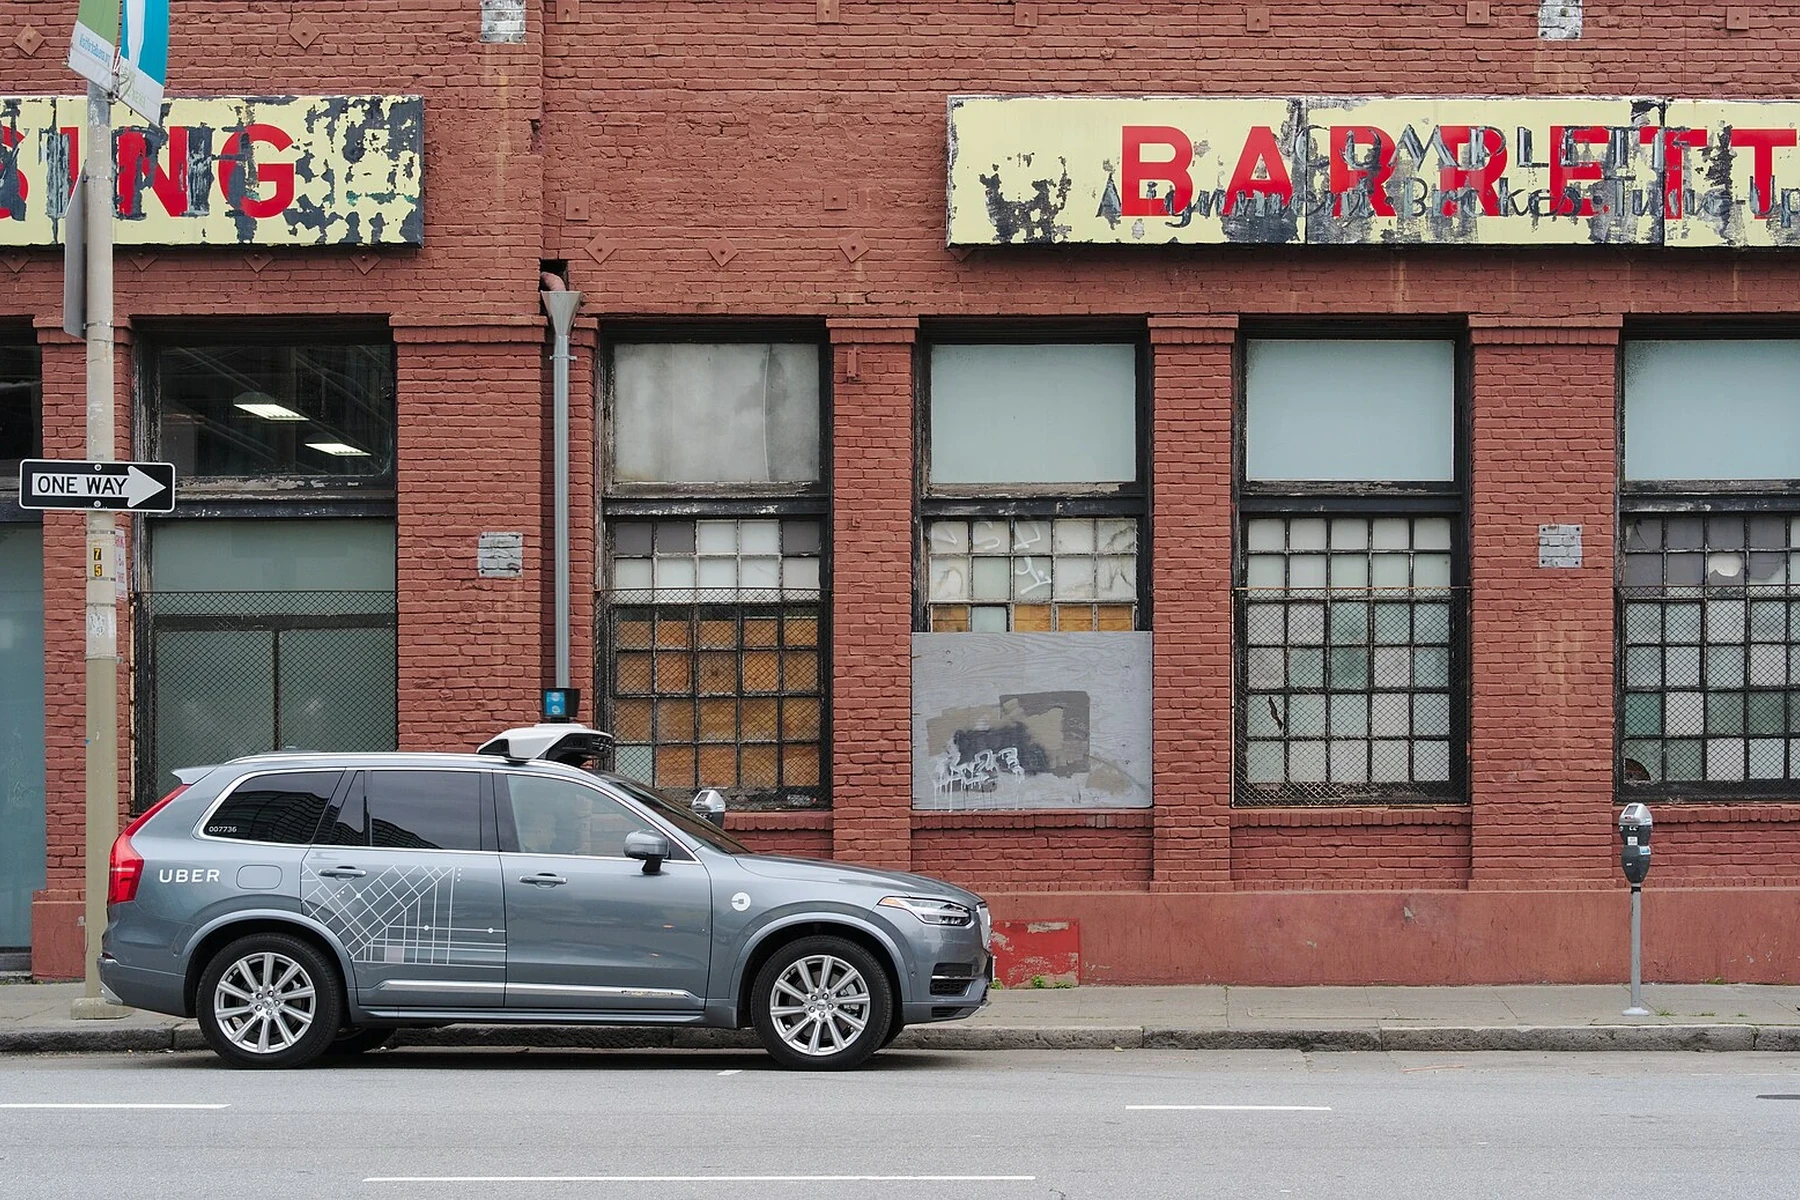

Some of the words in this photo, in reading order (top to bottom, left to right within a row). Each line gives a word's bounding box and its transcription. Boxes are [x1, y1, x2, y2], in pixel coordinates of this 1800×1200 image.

[1121, 125, 1797, 220] BARRETT
[37, 475, 78, 494] ONE
[86, 477, 128, 495] WAY
[208, 825, 238, 833] 007736
[159, 868, 220, 883] UBER
